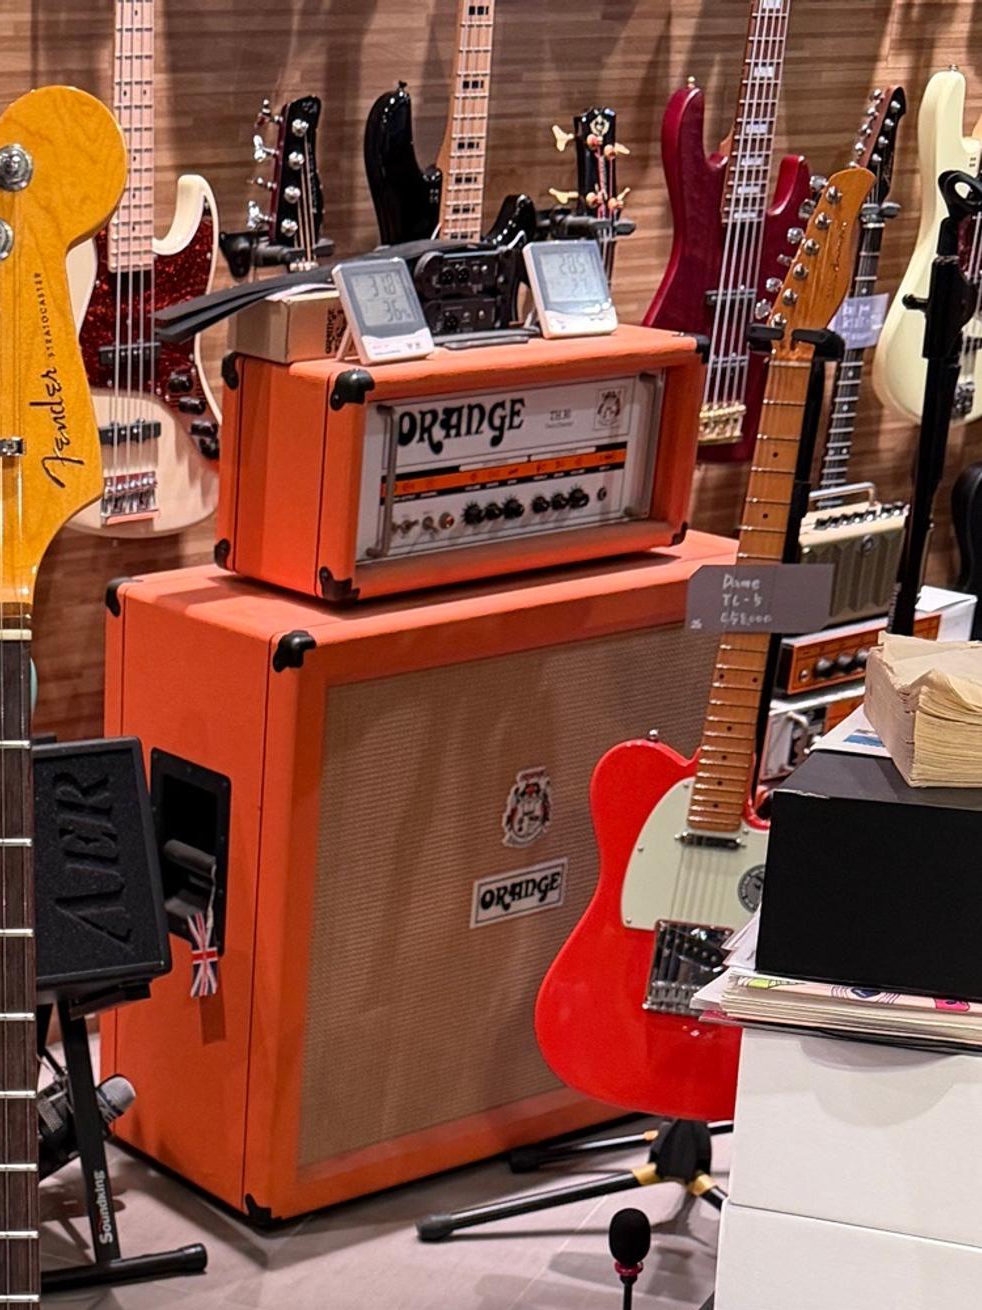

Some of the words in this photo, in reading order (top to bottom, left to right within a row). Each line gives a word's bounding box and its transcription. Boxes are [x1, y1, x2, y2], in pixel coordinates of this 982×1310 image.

[34, 271, 57, 358] STRATOCASTER
[29, 367, 85, 488] Fender
[397, 398, 525, 455] ORANGE
[721, 573, 761, 590] Dame
[479, 871, 562, 911] ORANGE
[93, 1169, 113, 1244] Soundking
